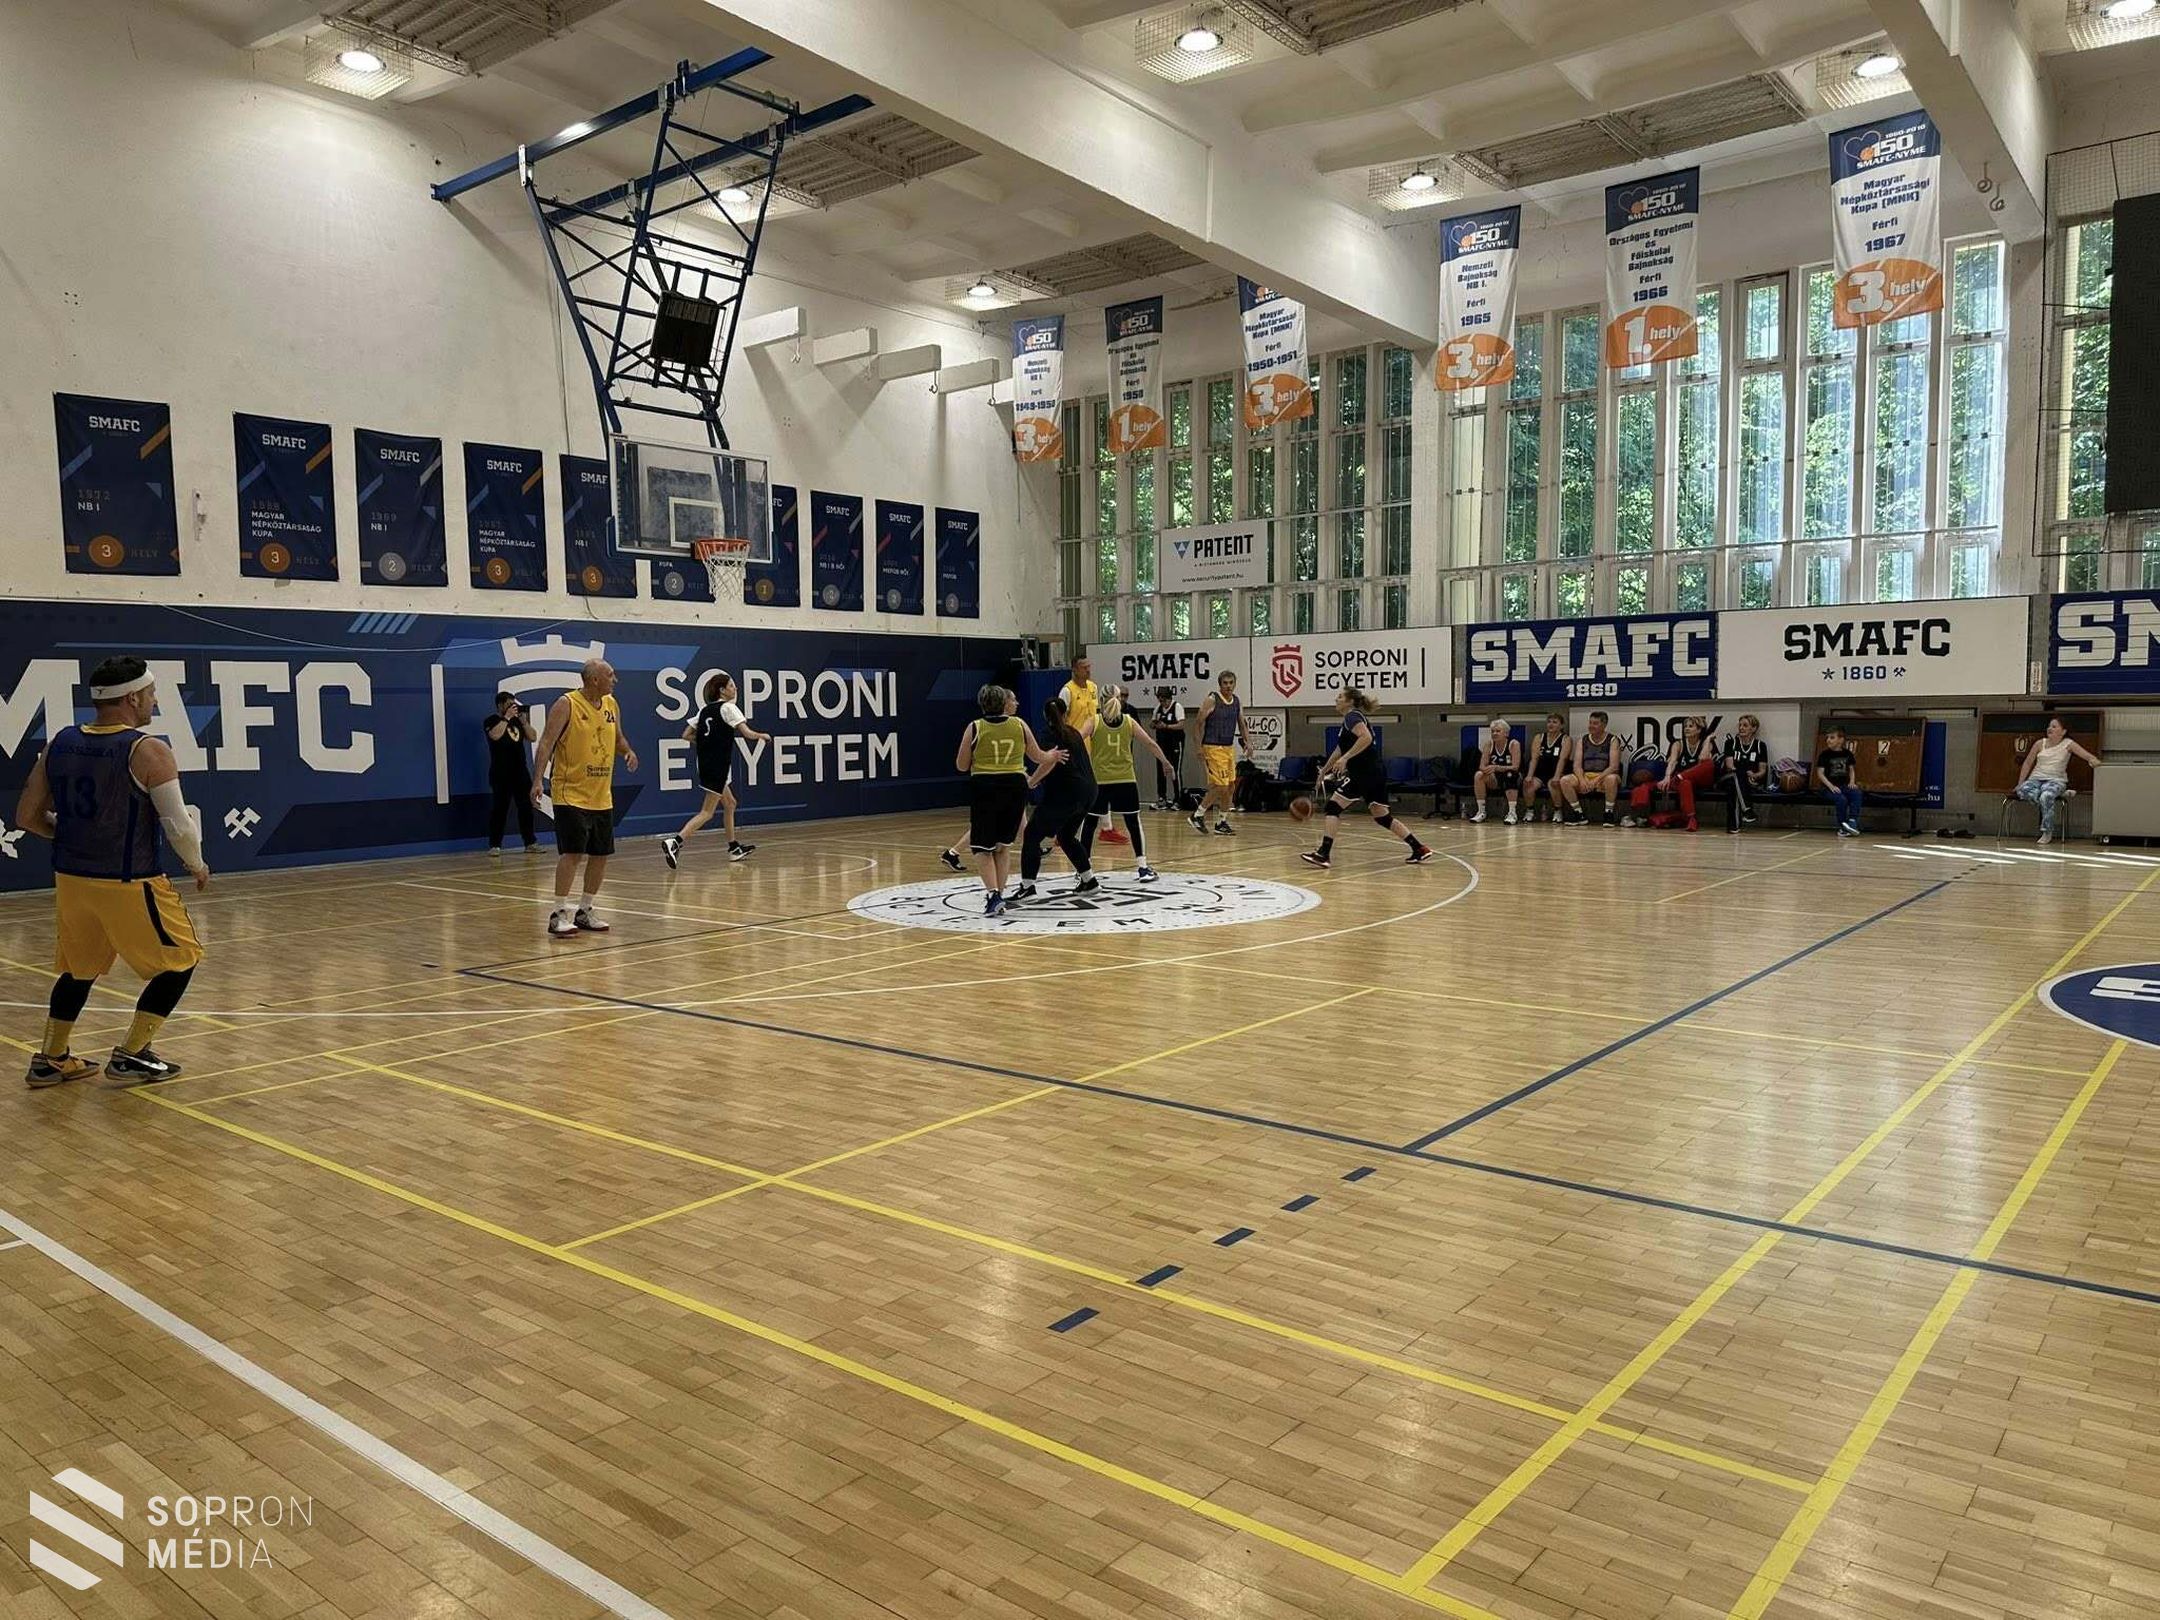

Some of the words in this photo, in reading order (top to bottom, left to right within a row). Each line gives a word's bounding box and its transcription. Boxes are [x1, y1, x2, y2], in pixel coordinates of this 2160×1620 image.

[1871, 134, 1914, 158] 150
[1856, 145, 1926, 169] SMAFC-NYME
[1863, 174, 1906, 191] Magyar
[1840, 178, 1930, 205] Népköztársasági
[1641, 191, 1676, 212] 150
[1850, 202, 1878, 214] Kupa
[1872, 217, 1898, 231] Férfi
[1470, 228, 1500, 245] 150
[1609, 231, 1651, 246] Országos
[1653, 220, 1694, 237] Egyetemi
[1644, 240, 1656, 248] és
[1864, 233, 1906, 252] 1967
[1630, 245, 1671, 261] Főiskolai
[1461, 260, 1494, 273] Nemzeti
[1628, 256, 1674, 272] Bajnokság
[1457, 269, 1498, 283] Bajnokság
[1639, 272, 1662, 284] Férfi
[1466, 281, 1480, 290] NB
[1889, 279, 1928, 297] hely
[1632, 285, 1668, 302] 1966
[1466, 298, 1486, 309] Férfi
[1460, 312, 1492, 327] 1965
[1649, 324, 1681, 340] hely
[1247, 350, 1298, 372] 1950-1951
[1476, 353, 1505, 367] hely
[1276, 389, 1300, 403] hely
[88, 415, 141, 433] SMAFC
[262, 433, 307, 450] SMAFC
[380, 448, 421, 464] SMAFC
[486, 460, 523, 474] SMAFC
[581, 472, 608, 485] SMAF
[77, 501, 94, 512] NB
[825, 505, 850, 517] SMAFC
[251, 511, 285, 520] MAGYAR
[888, 513, 912, 524] SMAFC
[251, 519, 322, 533] NÉPKÖZTÁRSASÁG
[370, 522, 383, 531] NB
[947, 520, 968, 531] SMAFC
[252, 530, 273, 538] KUPA
[479, 529, 505, 537] MAGYAR
[101, 544, 113, 558] 3
[1194, 534, 1254, 559] PATENT
[271, 551, 280, 564] 3
[388, 559, 397, 573] 2
[494, 564, 502, 576] 3
[590, 572, 597, 584] 3
[671, 578, 678, 589] 2
[1784, 618, 1952, 661] SMAFC
[1470, 620, 1710, 682] SMAFC
[1314, 648, 1408, 669] SOPRONI
[1122, 652, 1210, 682] SMAFC
[1842, 665, 1887, 681] 1860
[1315, 670, 1408, 690] EGYETEM
[1154, 685, 1178, 696] 10
[1565, 683, 1618, 698] 1860
[991, 738, 1015, 765] 17
[1107, 733, 1121, 756] 4
[1880, 741, 1889, 754] 2
[658, 732, 899, 791] EYETEM
